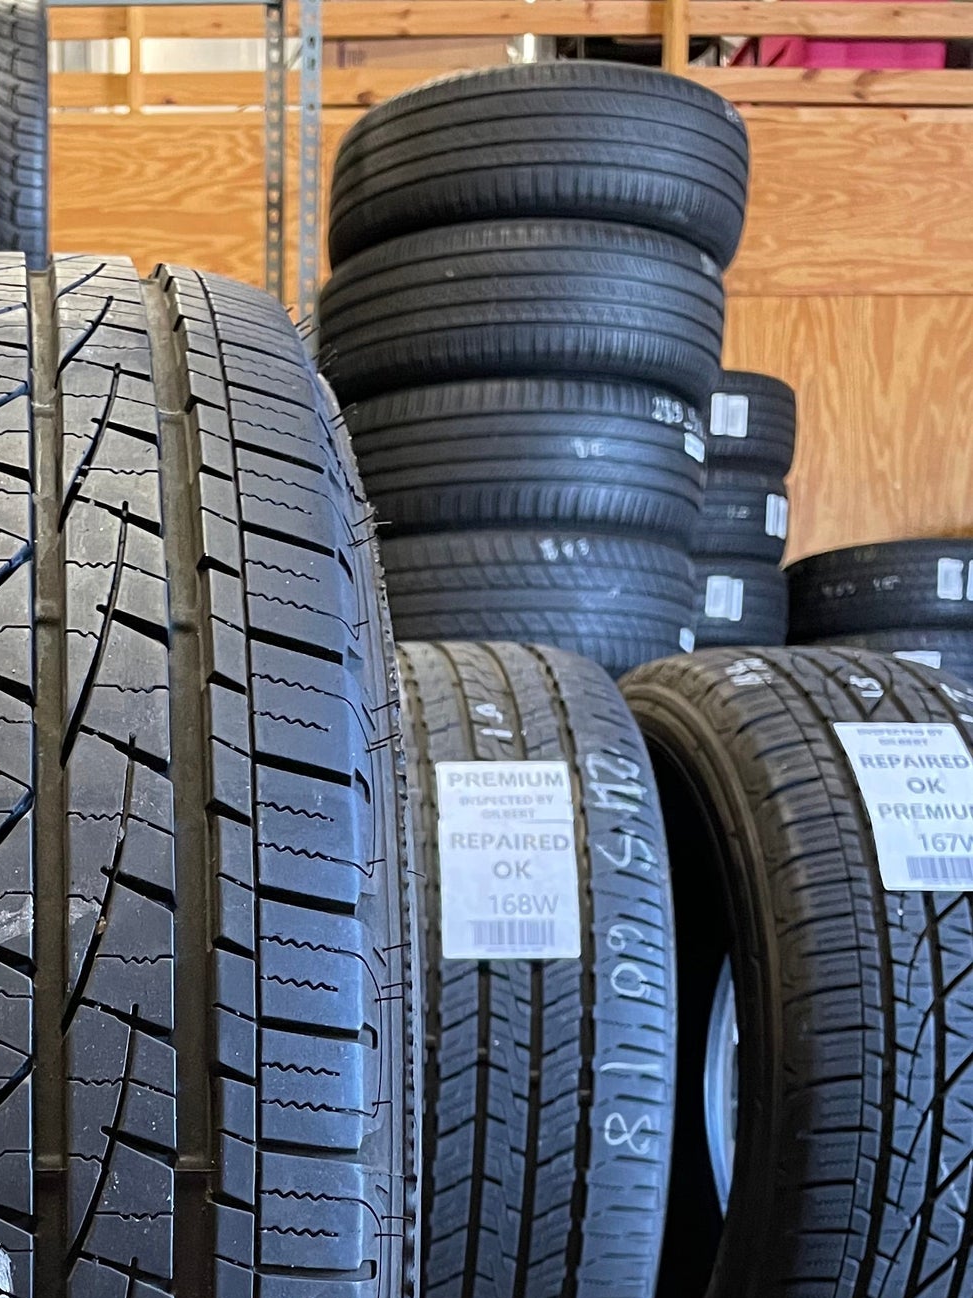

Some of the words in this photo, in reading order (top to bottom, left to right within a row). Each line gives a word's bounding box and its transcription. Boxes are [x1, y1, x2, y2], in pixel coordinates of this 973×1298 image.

[858, 754, 970, 769] REPAIRED
[447, 771, 565, 787] PREMIUM
[907, 777, 947, 795] OK
[877, 803, 973, 820] PREMIU
[450, 833, 571, 851] REPAIRED
[493, 861, 532, 880] OK
[489, 893, 559, 915] 168W
